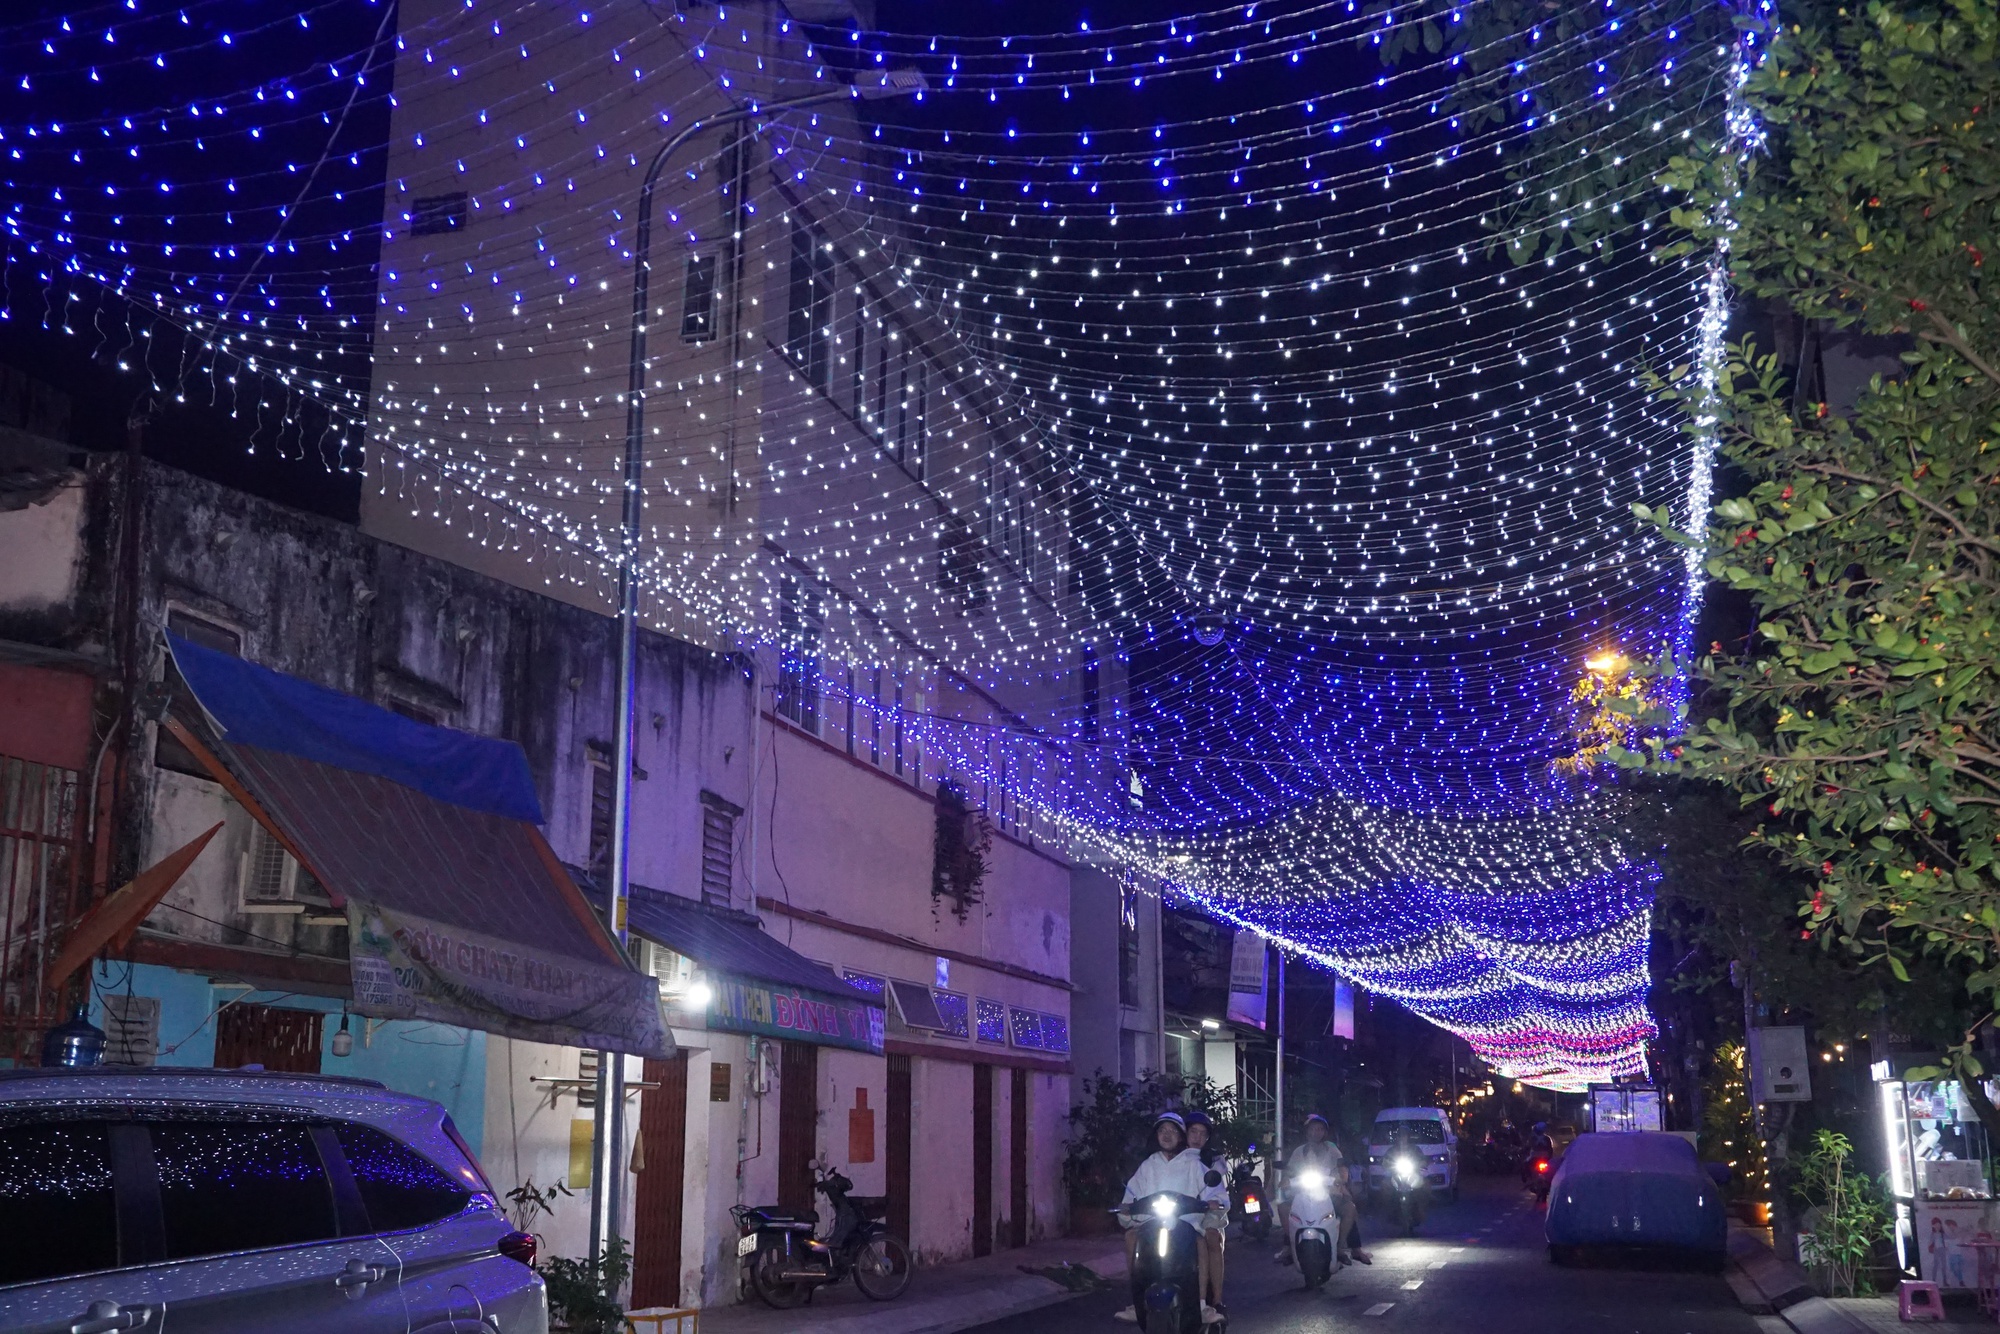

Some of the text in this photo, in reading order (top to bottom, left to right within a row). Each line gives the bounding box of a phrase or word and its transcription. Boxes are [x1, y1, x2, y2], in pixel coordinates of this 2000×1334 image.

[393, 925, 451, 971] CƠM
[456, 940, 518, 988] CHAY
[523, 957, 575, 999] KHAI
[394, 966, 424, 990] CƠM
[773, 988, 840, 1037] ĐÌNH
